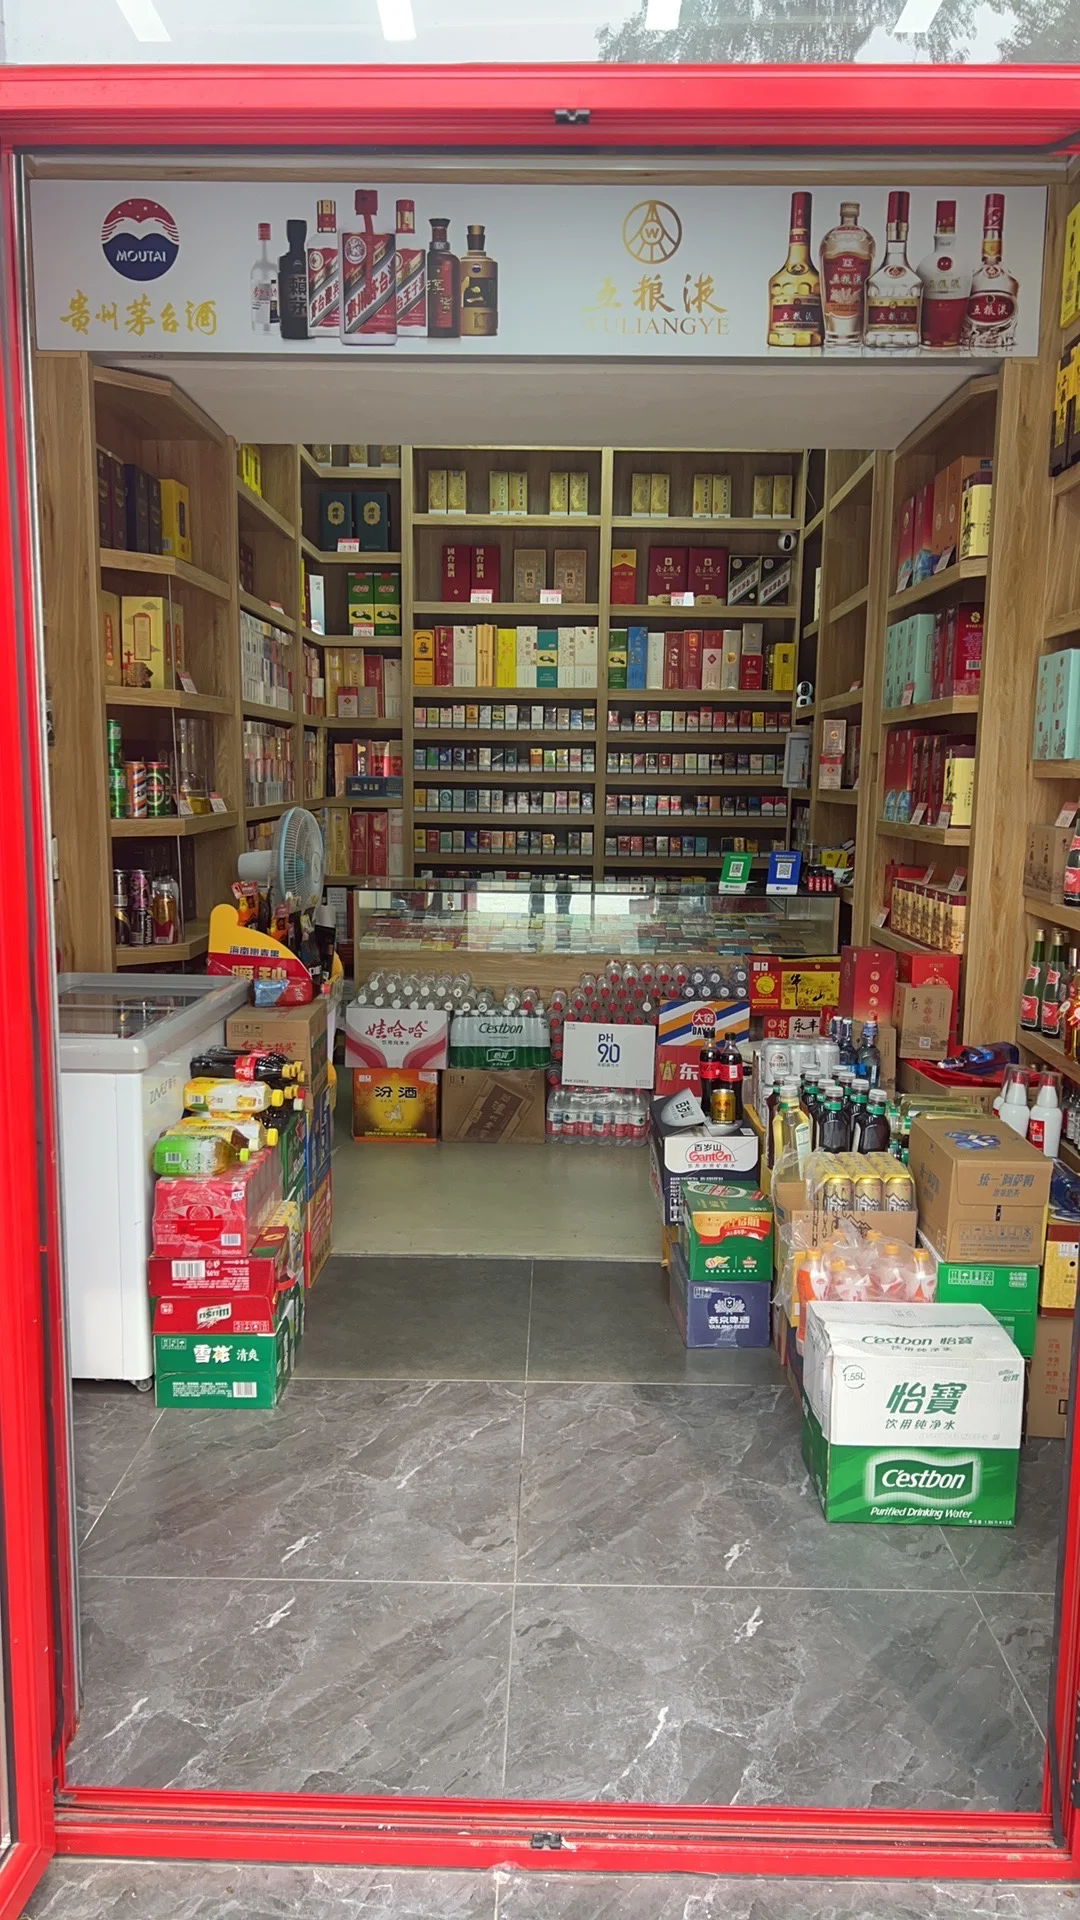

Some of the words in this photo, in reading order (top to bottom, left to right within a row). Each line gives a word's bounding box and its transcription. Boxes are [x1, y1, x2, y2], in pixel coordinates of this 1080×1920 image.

[116, 249, 167, 263] MOUTAI
[583, 273, 728, 314] 五粮液
[60, 289, 217, 336] 贵州茅台酒
[365, 1019, 428, 1039] 娃哈哈
[597, 1043, 620, 1063] 9.0
[374, 1086, 418, 1098] 汾酒
[694, 1143, 722, 1152] 百岁山
[193, 1344, 231, 1364] 雪花
[236, 1348, 260, 1362] 清爽
[885, 1418, 956, 1430] 饮用纯净水
[870, 1506, 906, 1517] Purified
[907, 1507, 943, 1520] Drinking
[945, 1508, 973, 1519] Water
